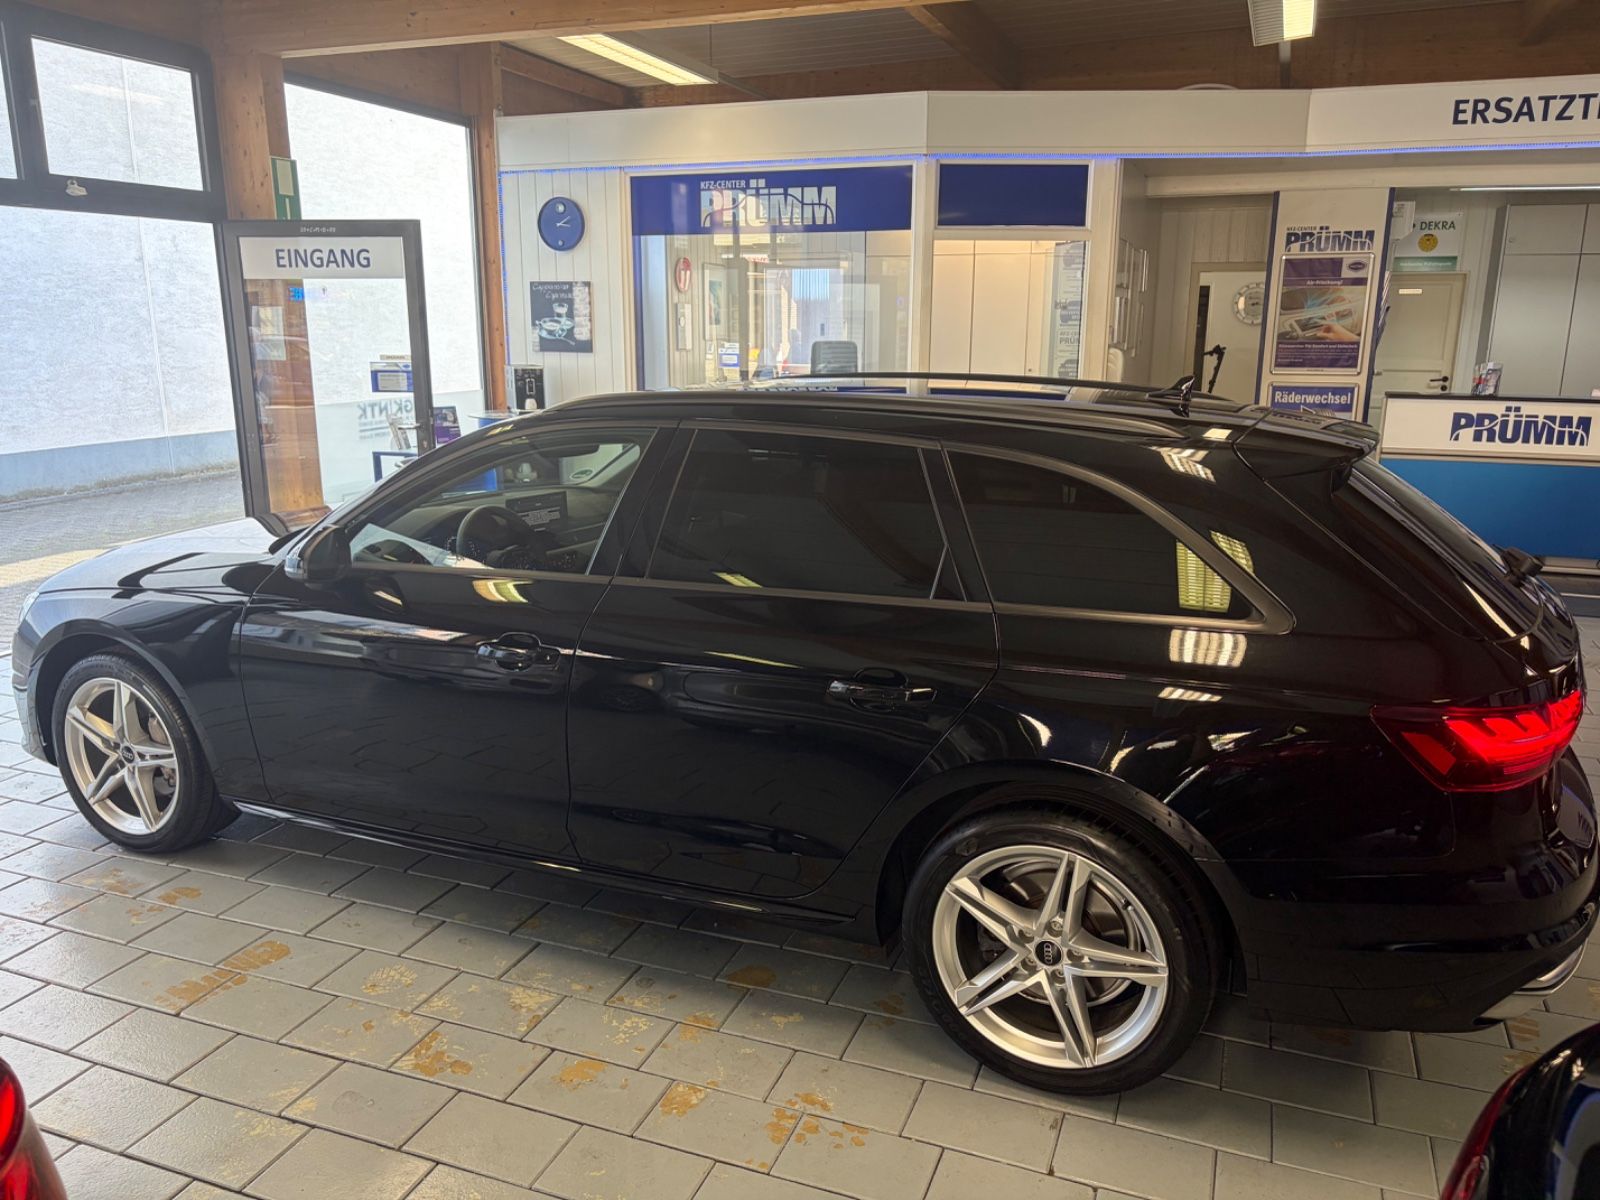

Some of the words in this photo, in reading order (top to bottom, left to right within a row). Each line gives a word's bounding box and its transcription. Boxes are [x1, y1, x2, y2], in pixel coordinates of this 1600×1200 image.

[1452, 93, 1600, 125] ERSATZT
[700, 180, 746, 189] KFZ-CENTER
[700, 178, 837, 228] PRÜMM
[1419, 221, 1456, 231] DEKRA
[1285, 225, 1375, 252] PRÜMM
[275, 248, 371, 268] EINGANG
[1274, 391, 1351, 404] Räderwechsel
[1450, 405, 1592, 446] PRÜMM
